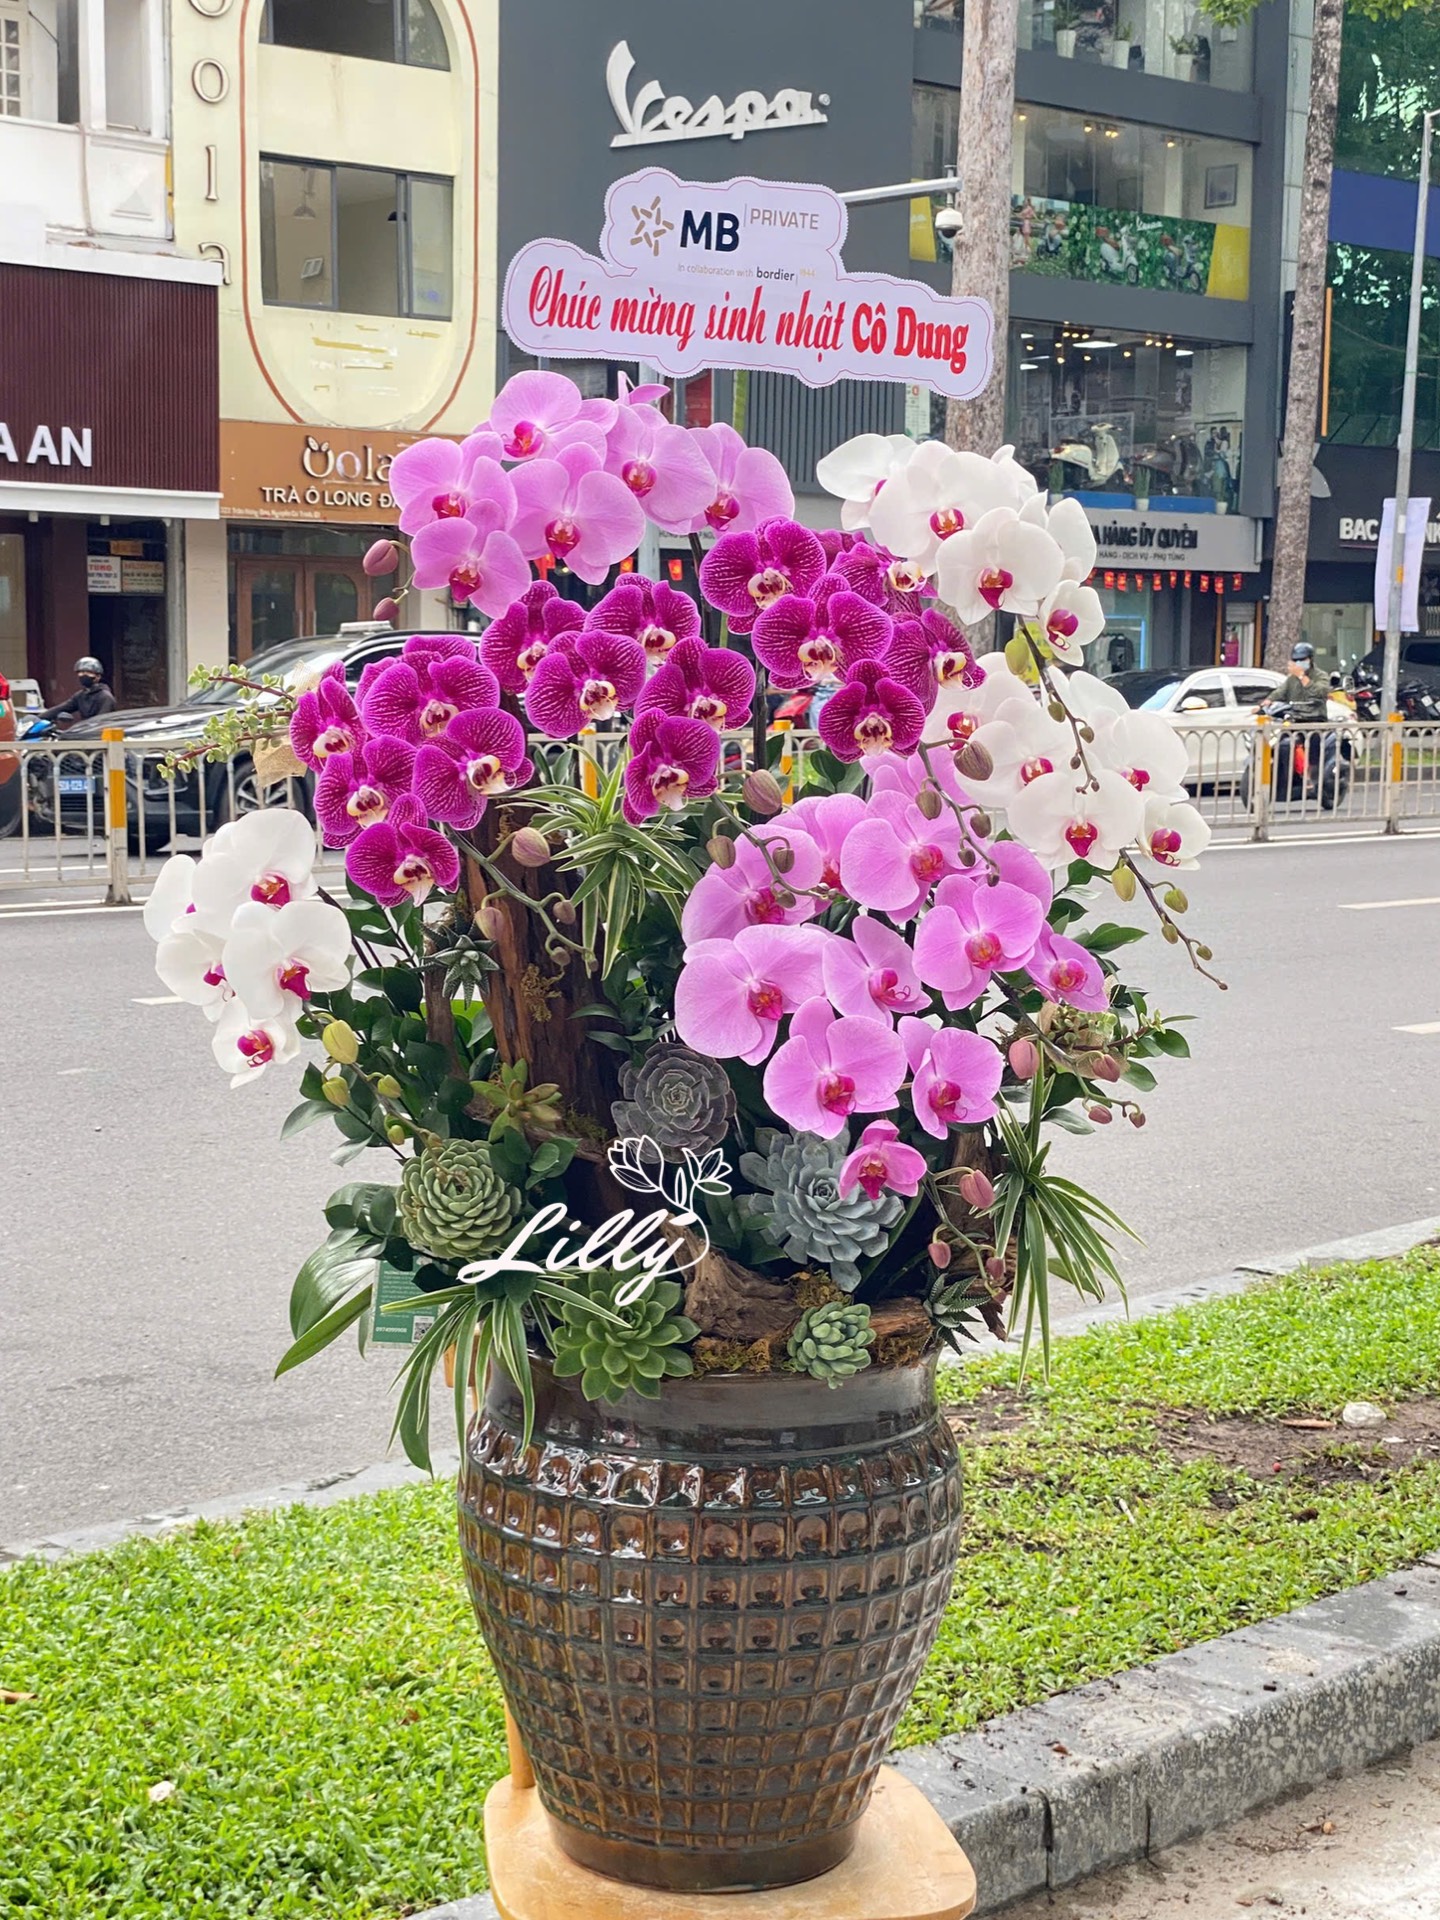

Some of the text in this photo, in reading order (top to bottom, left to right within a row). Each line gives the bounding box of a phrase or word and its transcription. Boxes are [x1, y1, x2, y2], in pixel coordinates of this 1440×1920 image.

[606, 40, 830, 148] Vespa
[680, 208, 820, 252] MB PRIVATE
[687, 265, 735, 277] collaboration
[737, 268, 753, 278] with
[756, 266, 795, 281] bordier
[527, 264, 968, 374] Chúc mừng sinh nhật Cô Dung
[26, 424, 92, 468] AN
[262, 485, 301, 504] TRÀ
[305, 485, 320, 504] Ô
[324, 489, 372, 507] LONG
[1339, 517, 1379, 541] BAC
